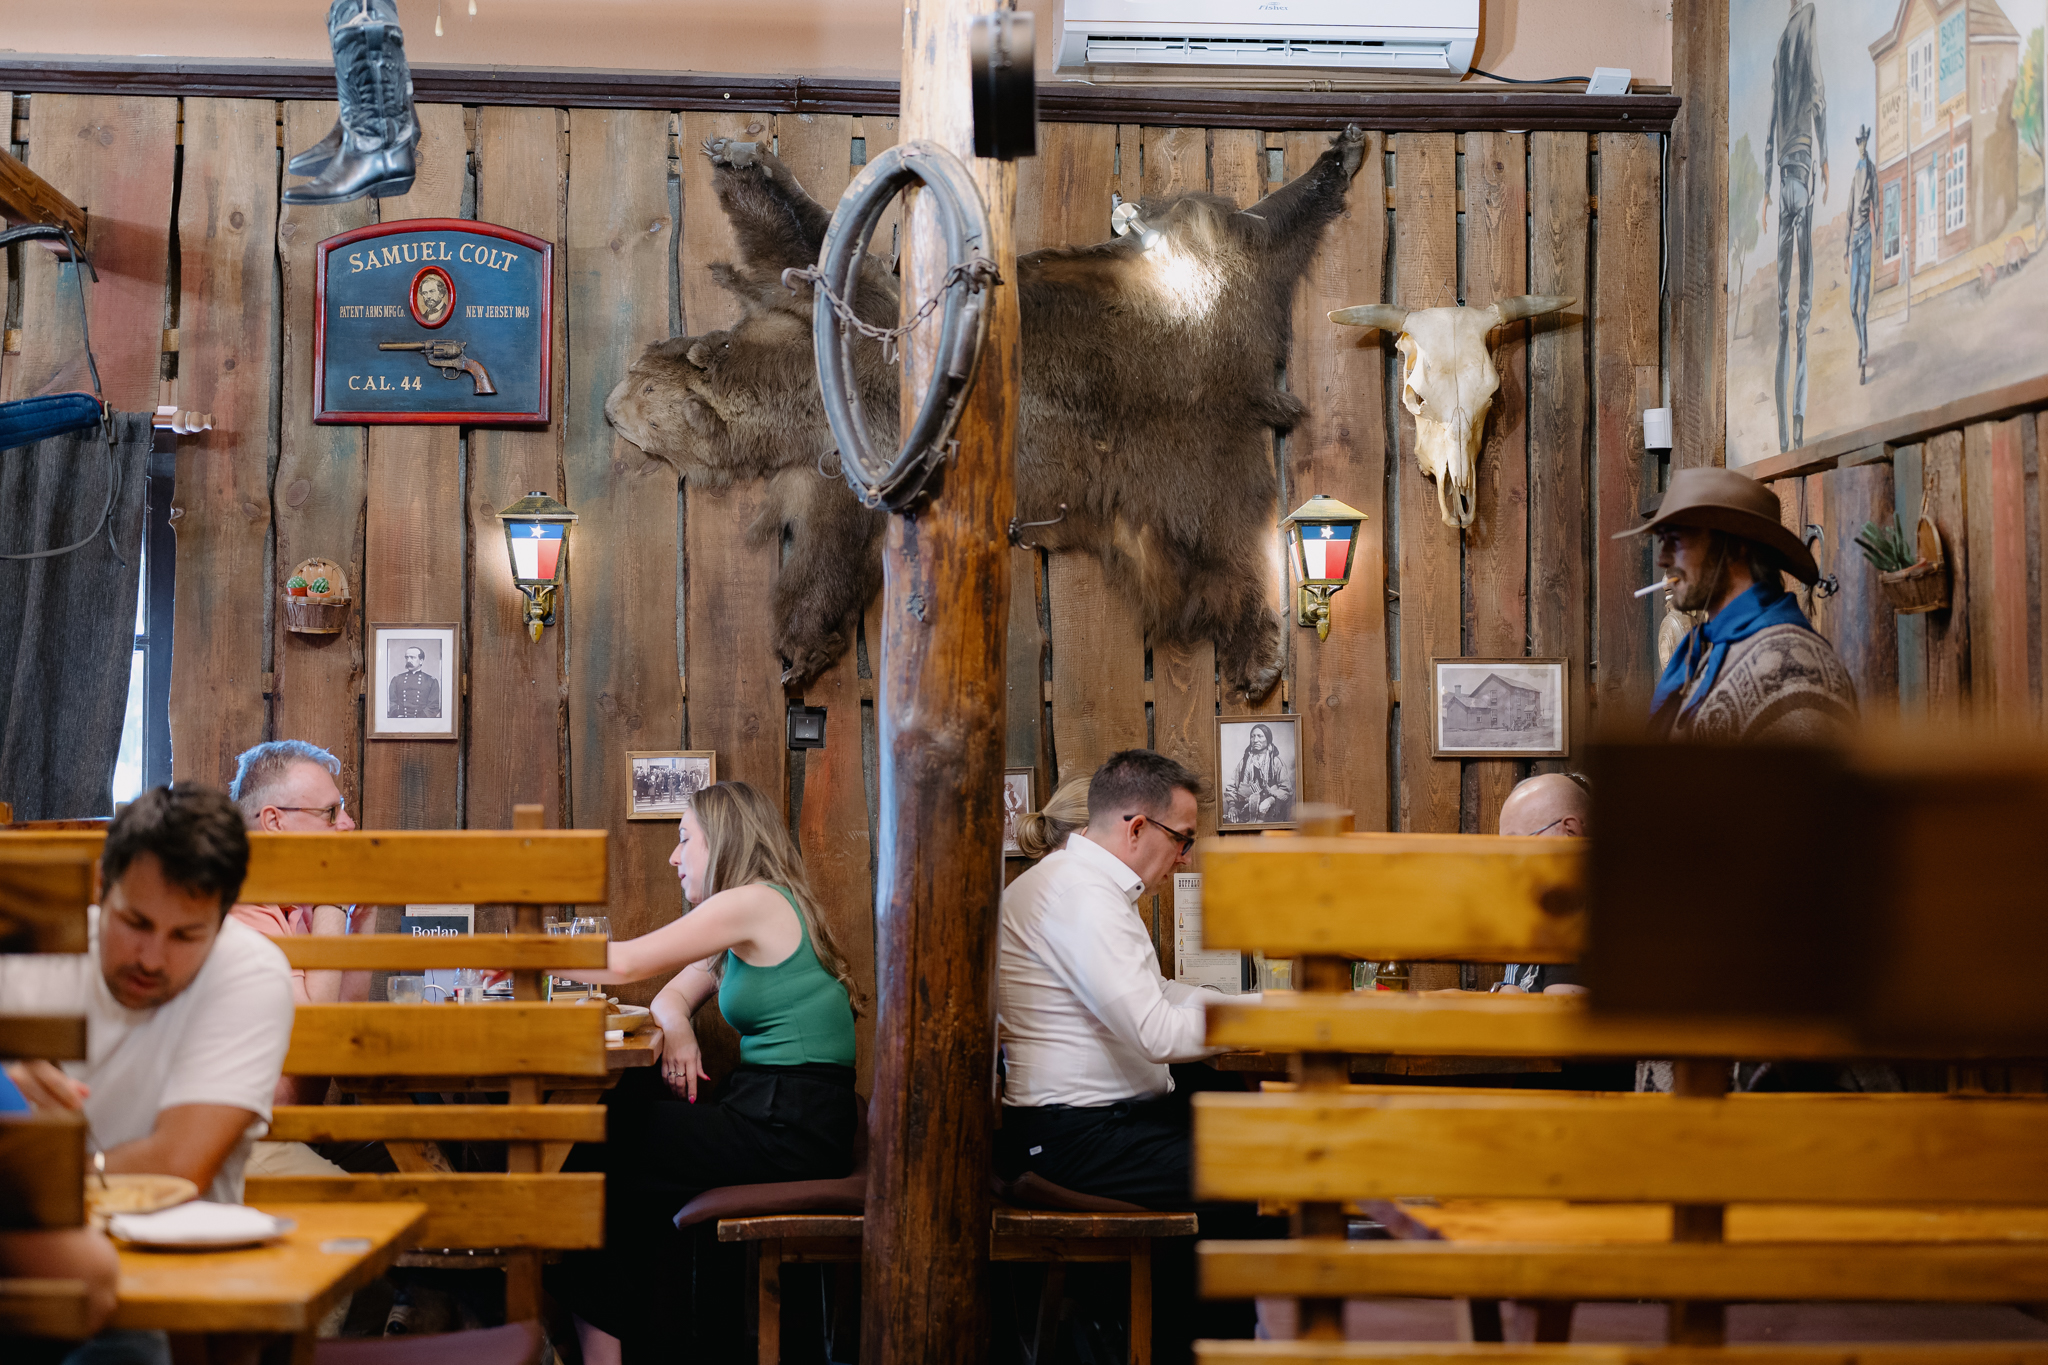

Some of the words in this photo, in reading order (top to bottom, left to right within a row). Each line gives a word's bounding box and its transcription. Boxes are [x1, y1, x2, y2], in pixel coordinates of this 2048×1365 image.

[349, 242, 452, 273] SAMUEL
[459, 243, 518, 272] COLT
[340, 305, 364, 318] PATENT
[365, 305, 383, 318] ARMS
[383, 305, 397, 318] MFG
[466, 305, 484, 318] NEW
[485, 305, 514, 318] JERSEY
[515, 305, 530, 318] 1843
[348, 375, 396, 391] CAL.
[400, 375, 422, 391] 44
[411, 925, 459, 938] Borlap
